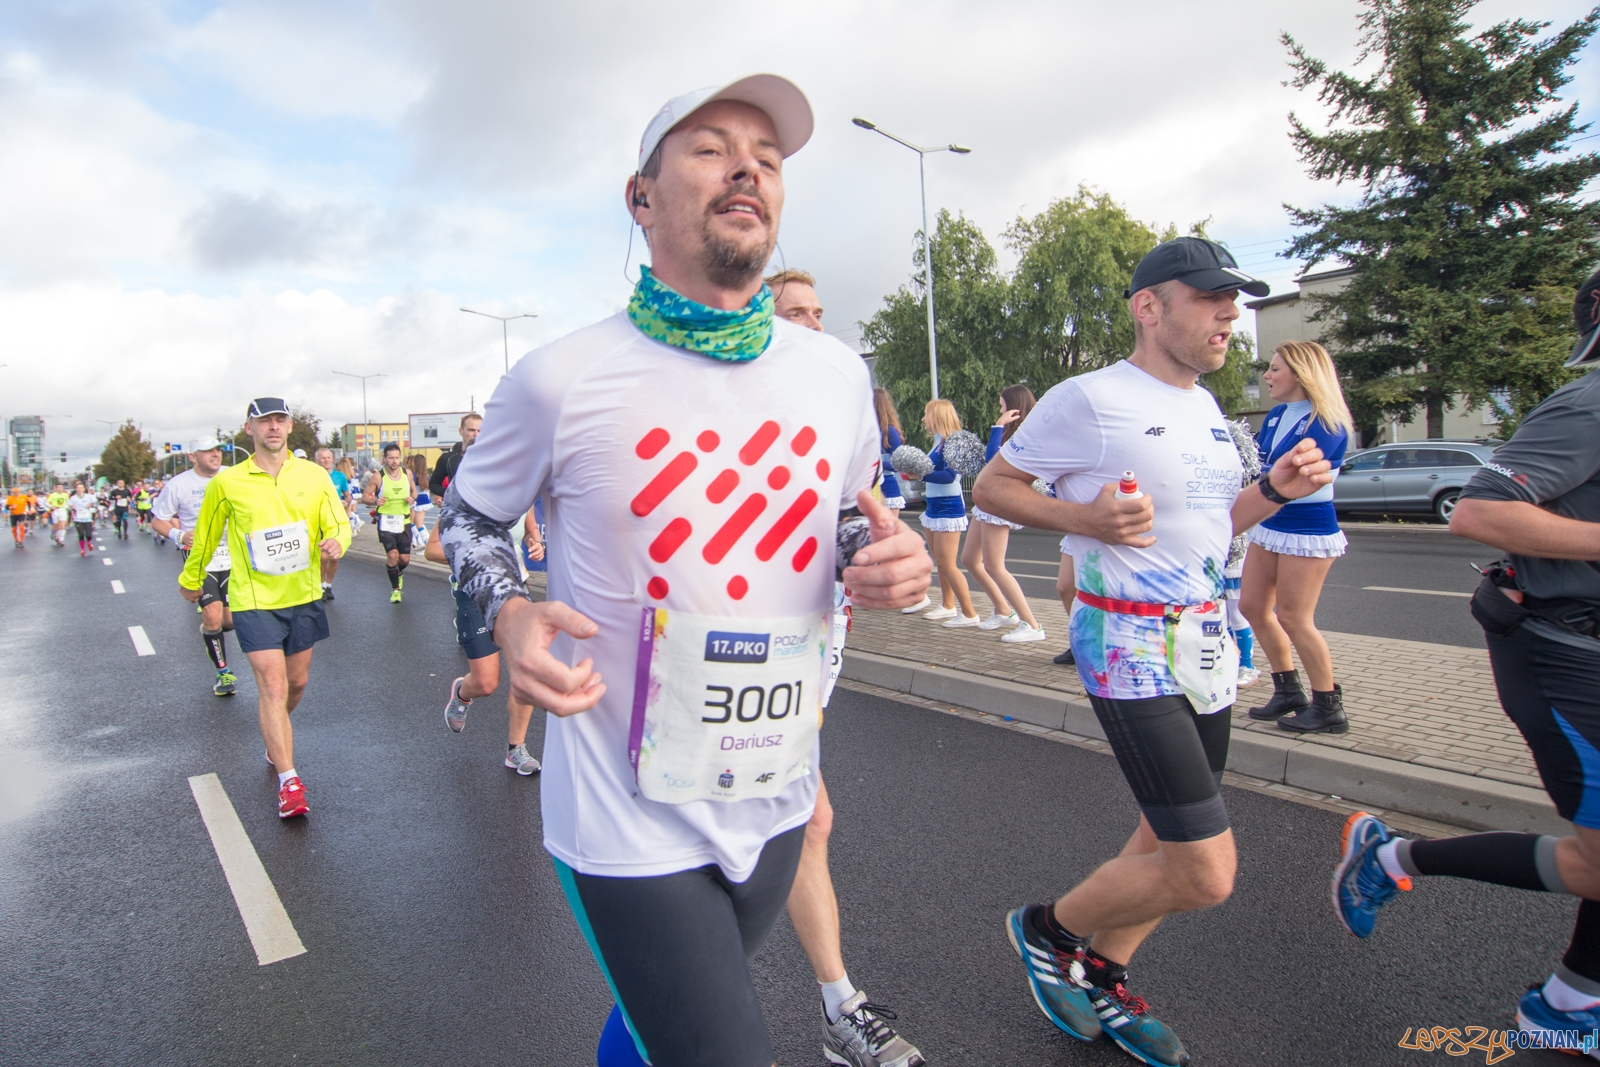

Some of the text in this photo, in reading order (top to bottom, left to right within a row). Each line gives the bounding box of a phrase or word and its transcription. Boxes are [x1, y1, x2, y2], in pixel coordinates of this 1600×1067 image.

[1194, 467, 1239, 481] ODWAGA
[1186, 481, 1239, 496] SZYBKOŚĆ
[266, 538, 301, 557] 5799
[701, 680, 803, 724] 3001
[720, 734, 784, 751] Dariusz
